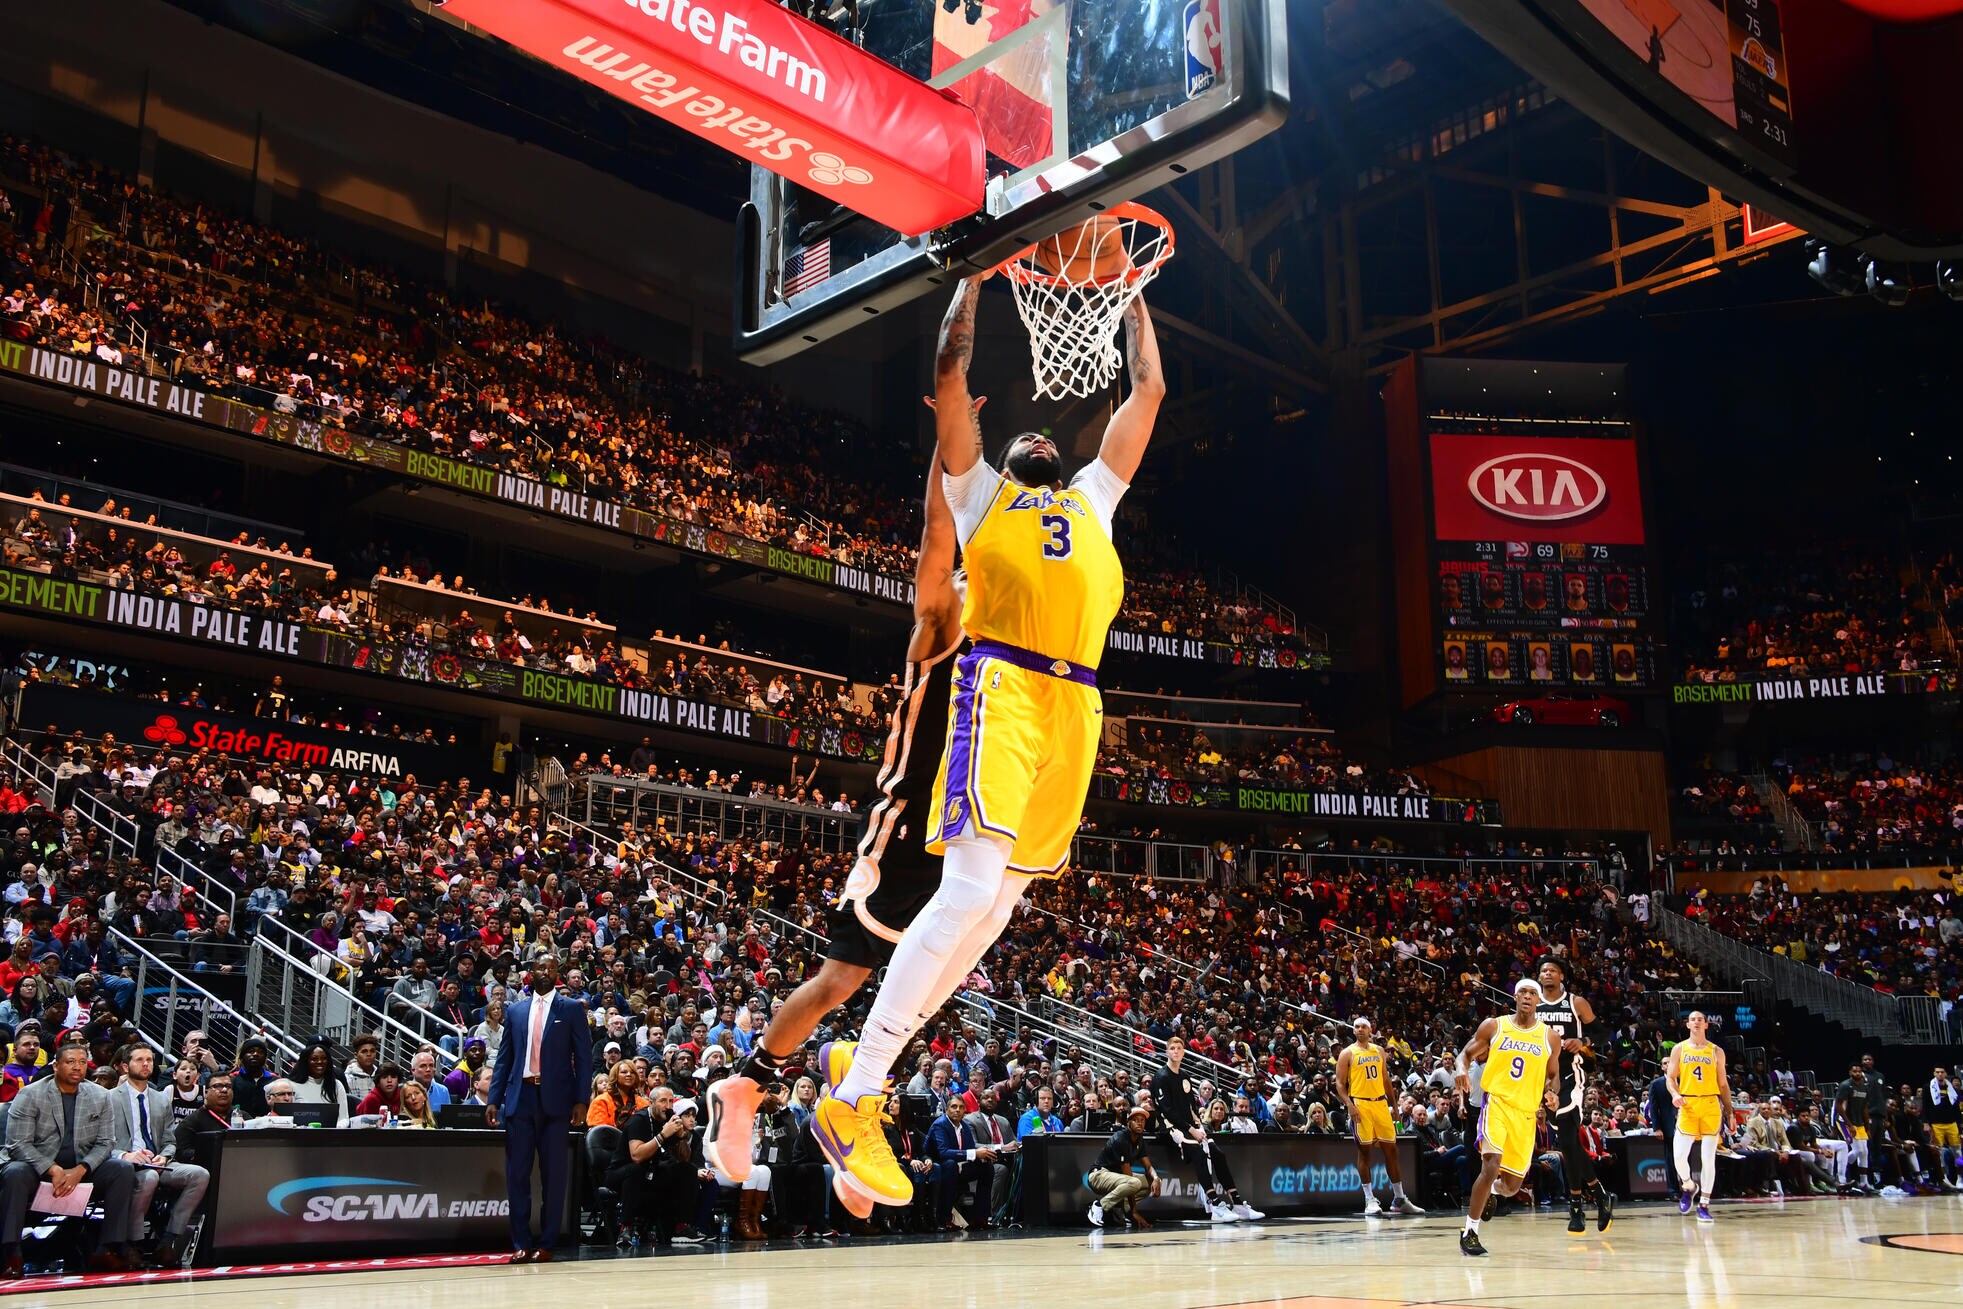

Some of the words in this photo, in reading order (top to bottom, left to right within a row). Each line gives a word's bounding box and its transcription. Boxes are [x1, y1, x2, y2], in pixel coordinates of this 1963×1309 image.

[1745, 13, 1761, 37] 75
[1191, 71, 1210, 90] NBA
[1763, 119, 1788, 146] 2:31
[29, 348, 96, 391] INDIA
[106, 368, 160, 407] PALE
[166, 385, 205, 419] ALE
[406, 449, 495, 493] BASEMENT
[497, 474, 545, 508] INDIA
[550, 487, 588, 520] PALE
[593, 500, 621, 528] ALE
[1491, 468, 1585, 507] KIA
[1040, 513, 1073, 562] 3
[1475, 543, 1497, 553] 2:31
[1537, 545, 1554, 558] 69
[1591, 546, 1609, 559] 75
[767, 547, 833, 583] BASEMENT
[834, 565, 870, 593] INDIA
[874, 581, 903, 602] PALE
[107, 590, 181, 634] INDIA
[191, 605, 251, 646] PALE
[258, 619, 301, 655] ALE
[1109, 630, 1144, 654] INDIA
[1148, 634, 1179, 658] PALE
[1183, 639, 1204, 660] ALE
[1673, 683, 1752, 703] BASEMENT
[1756, 680, 1802, 701] INDIA
[1809, 676, 1850, 698] PALE
[1856, 675, 1886, 695] ALE
[522, 670, 616, 712] BASEMENT
[620, 688, 670, 723] INDIA
[676, 699, 717, 732] PALE
[722, 709, 751, 738] ALE
[189, 721, 262, 754] State
[263, 732, 329, 765] Farm
[1238, 788, 1310, 813] BASEMENT
[1314, 793, 1357, 816] INDIA
[1362, 794, 1399, 817] PALE
[1403, 796, 1429, 819] ALE
[1498, 1036, 1543, 1056] LAKERS
[1683, 1054, 1712, 1065] LAKERS
[1357, 1056, 1381, 1066] LAKERS
[1365, 1064, 1379, 1081] 10
[1510, 1056, 1525, 1081] 9
[1692, 1065, 1704, 1083] 4
[1270, 1165, 1308, 1194] GET
[1309, 1163, 1362, 1193] FIRED
[302, 1193, 439, 1222] SCANA
[447, 1199, 510, 1218] ENERG
